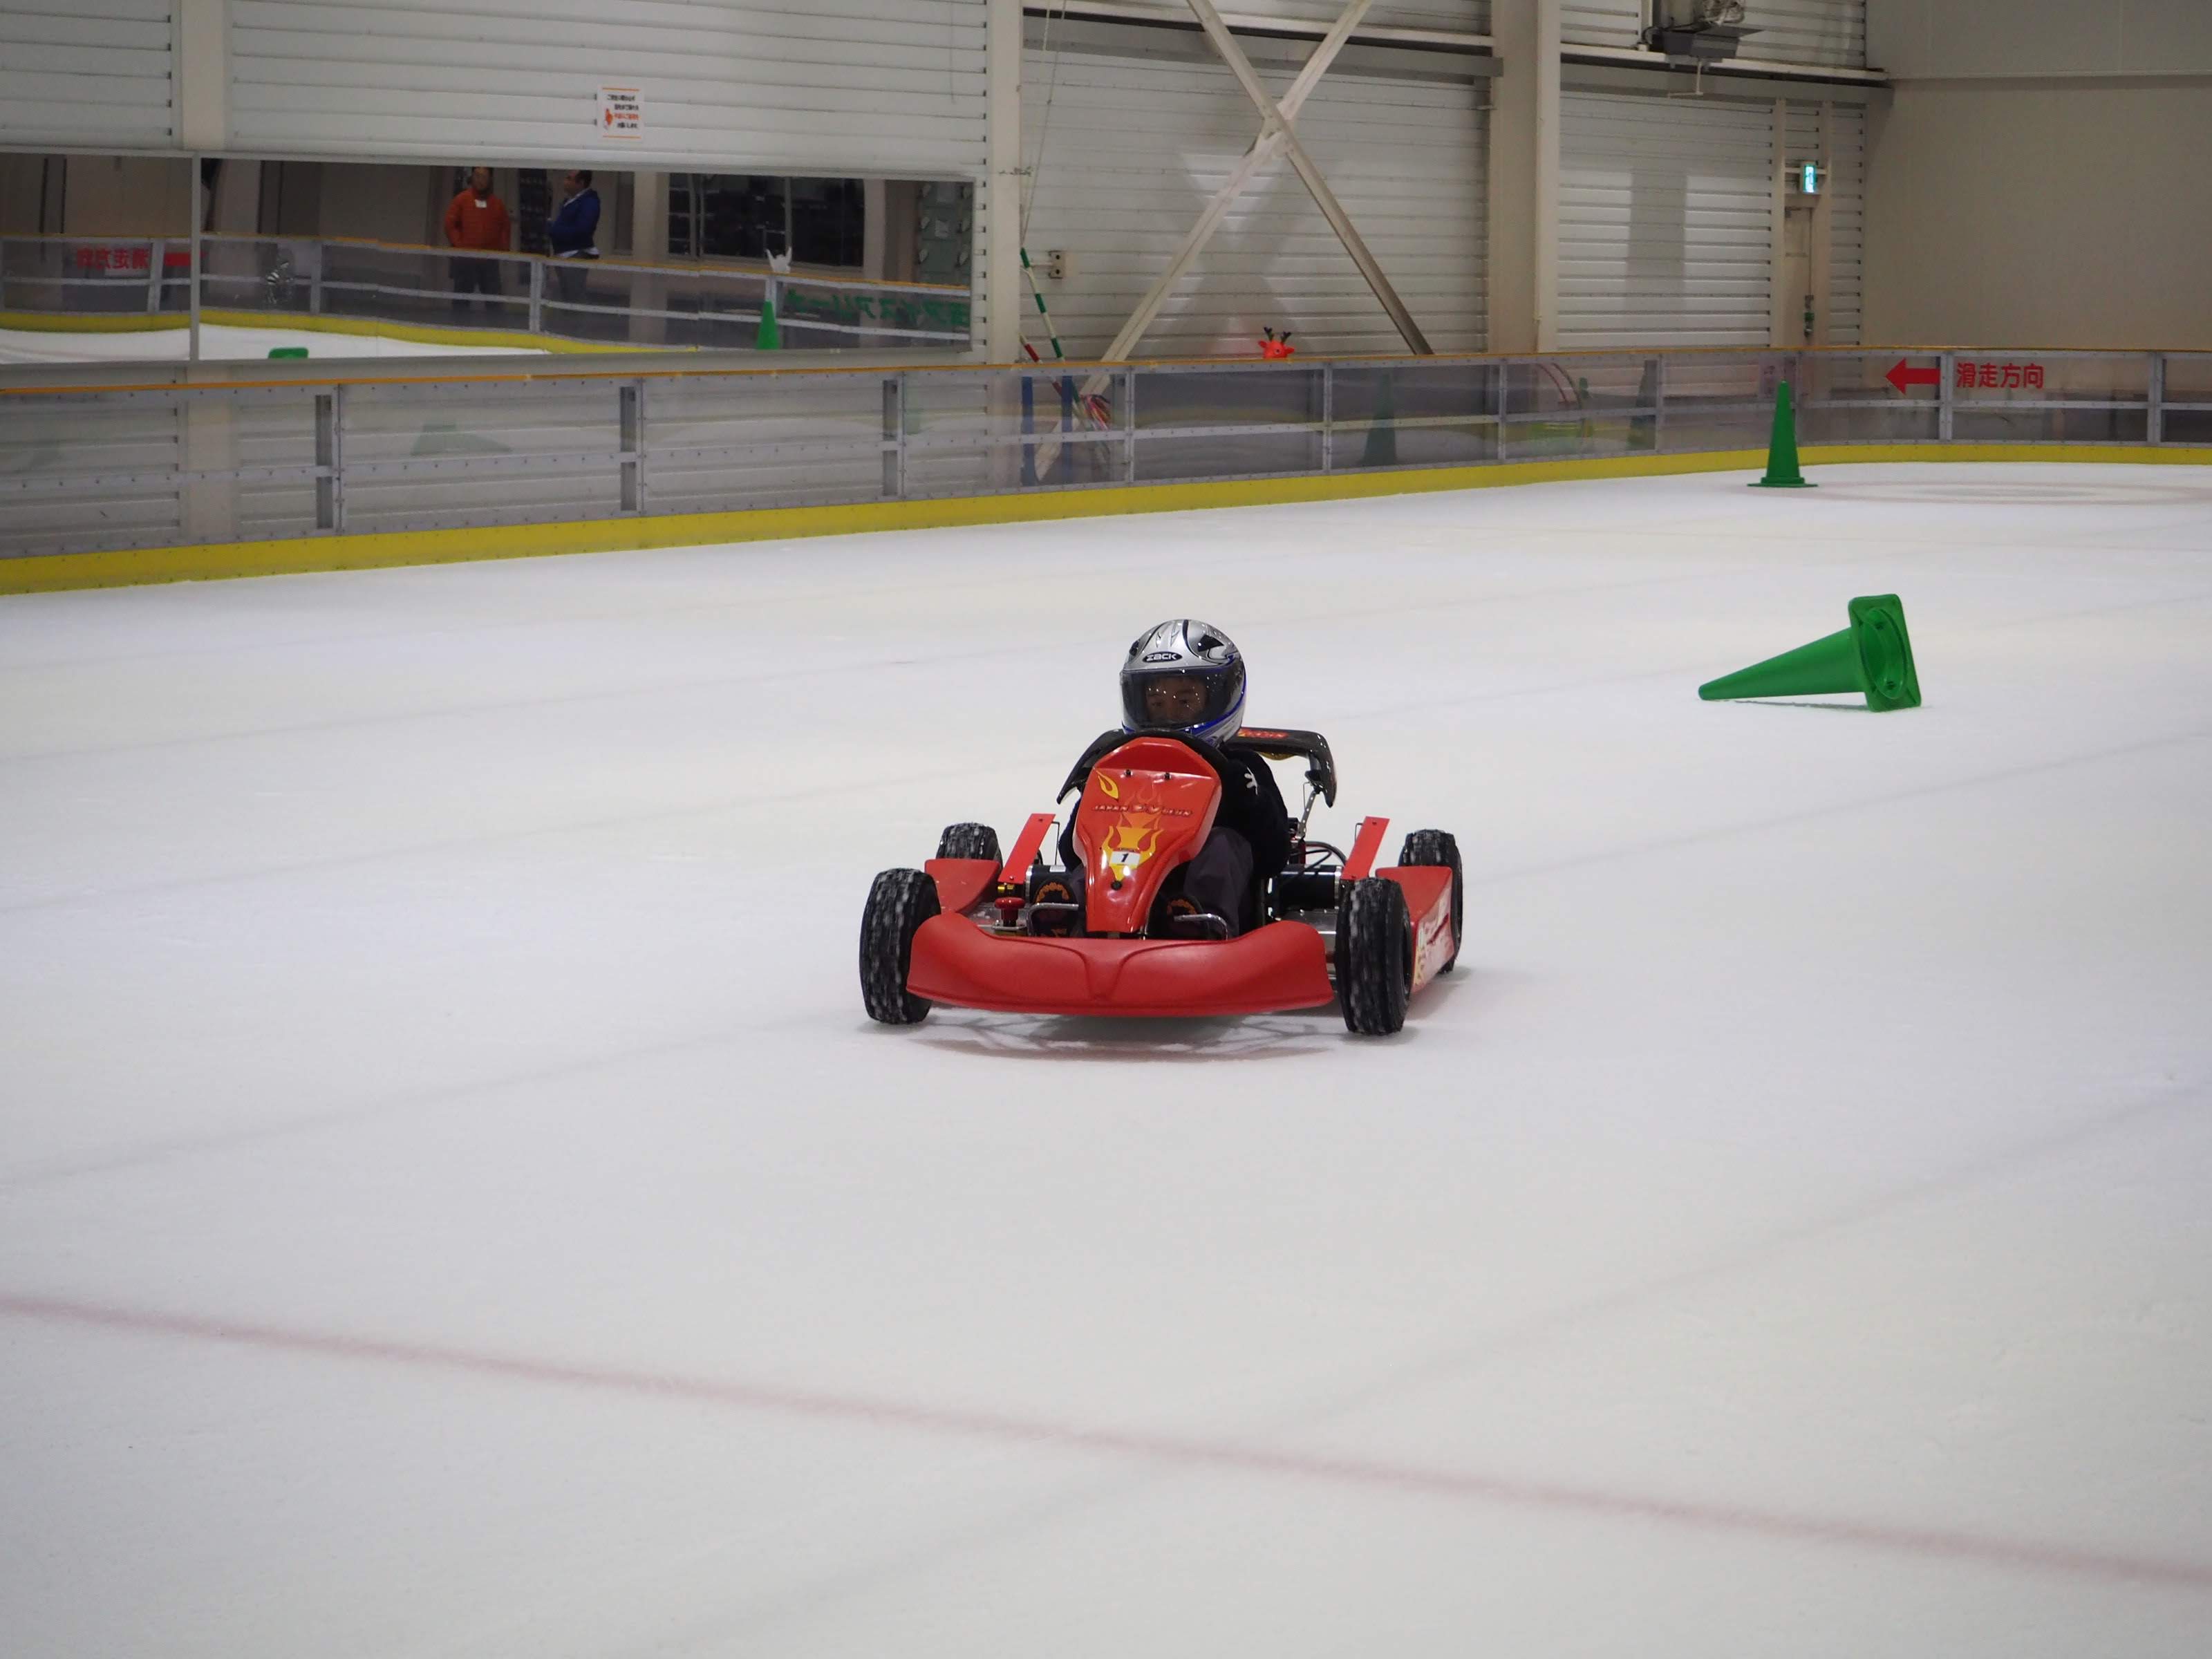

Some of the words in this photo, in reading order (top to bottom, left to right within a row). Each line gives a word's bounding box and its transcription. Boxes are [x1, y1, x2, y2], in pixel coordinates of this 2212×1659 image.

[1956, 362, 2044, 388] 滑走方向
[1121, 853, 1130, 863] 1
